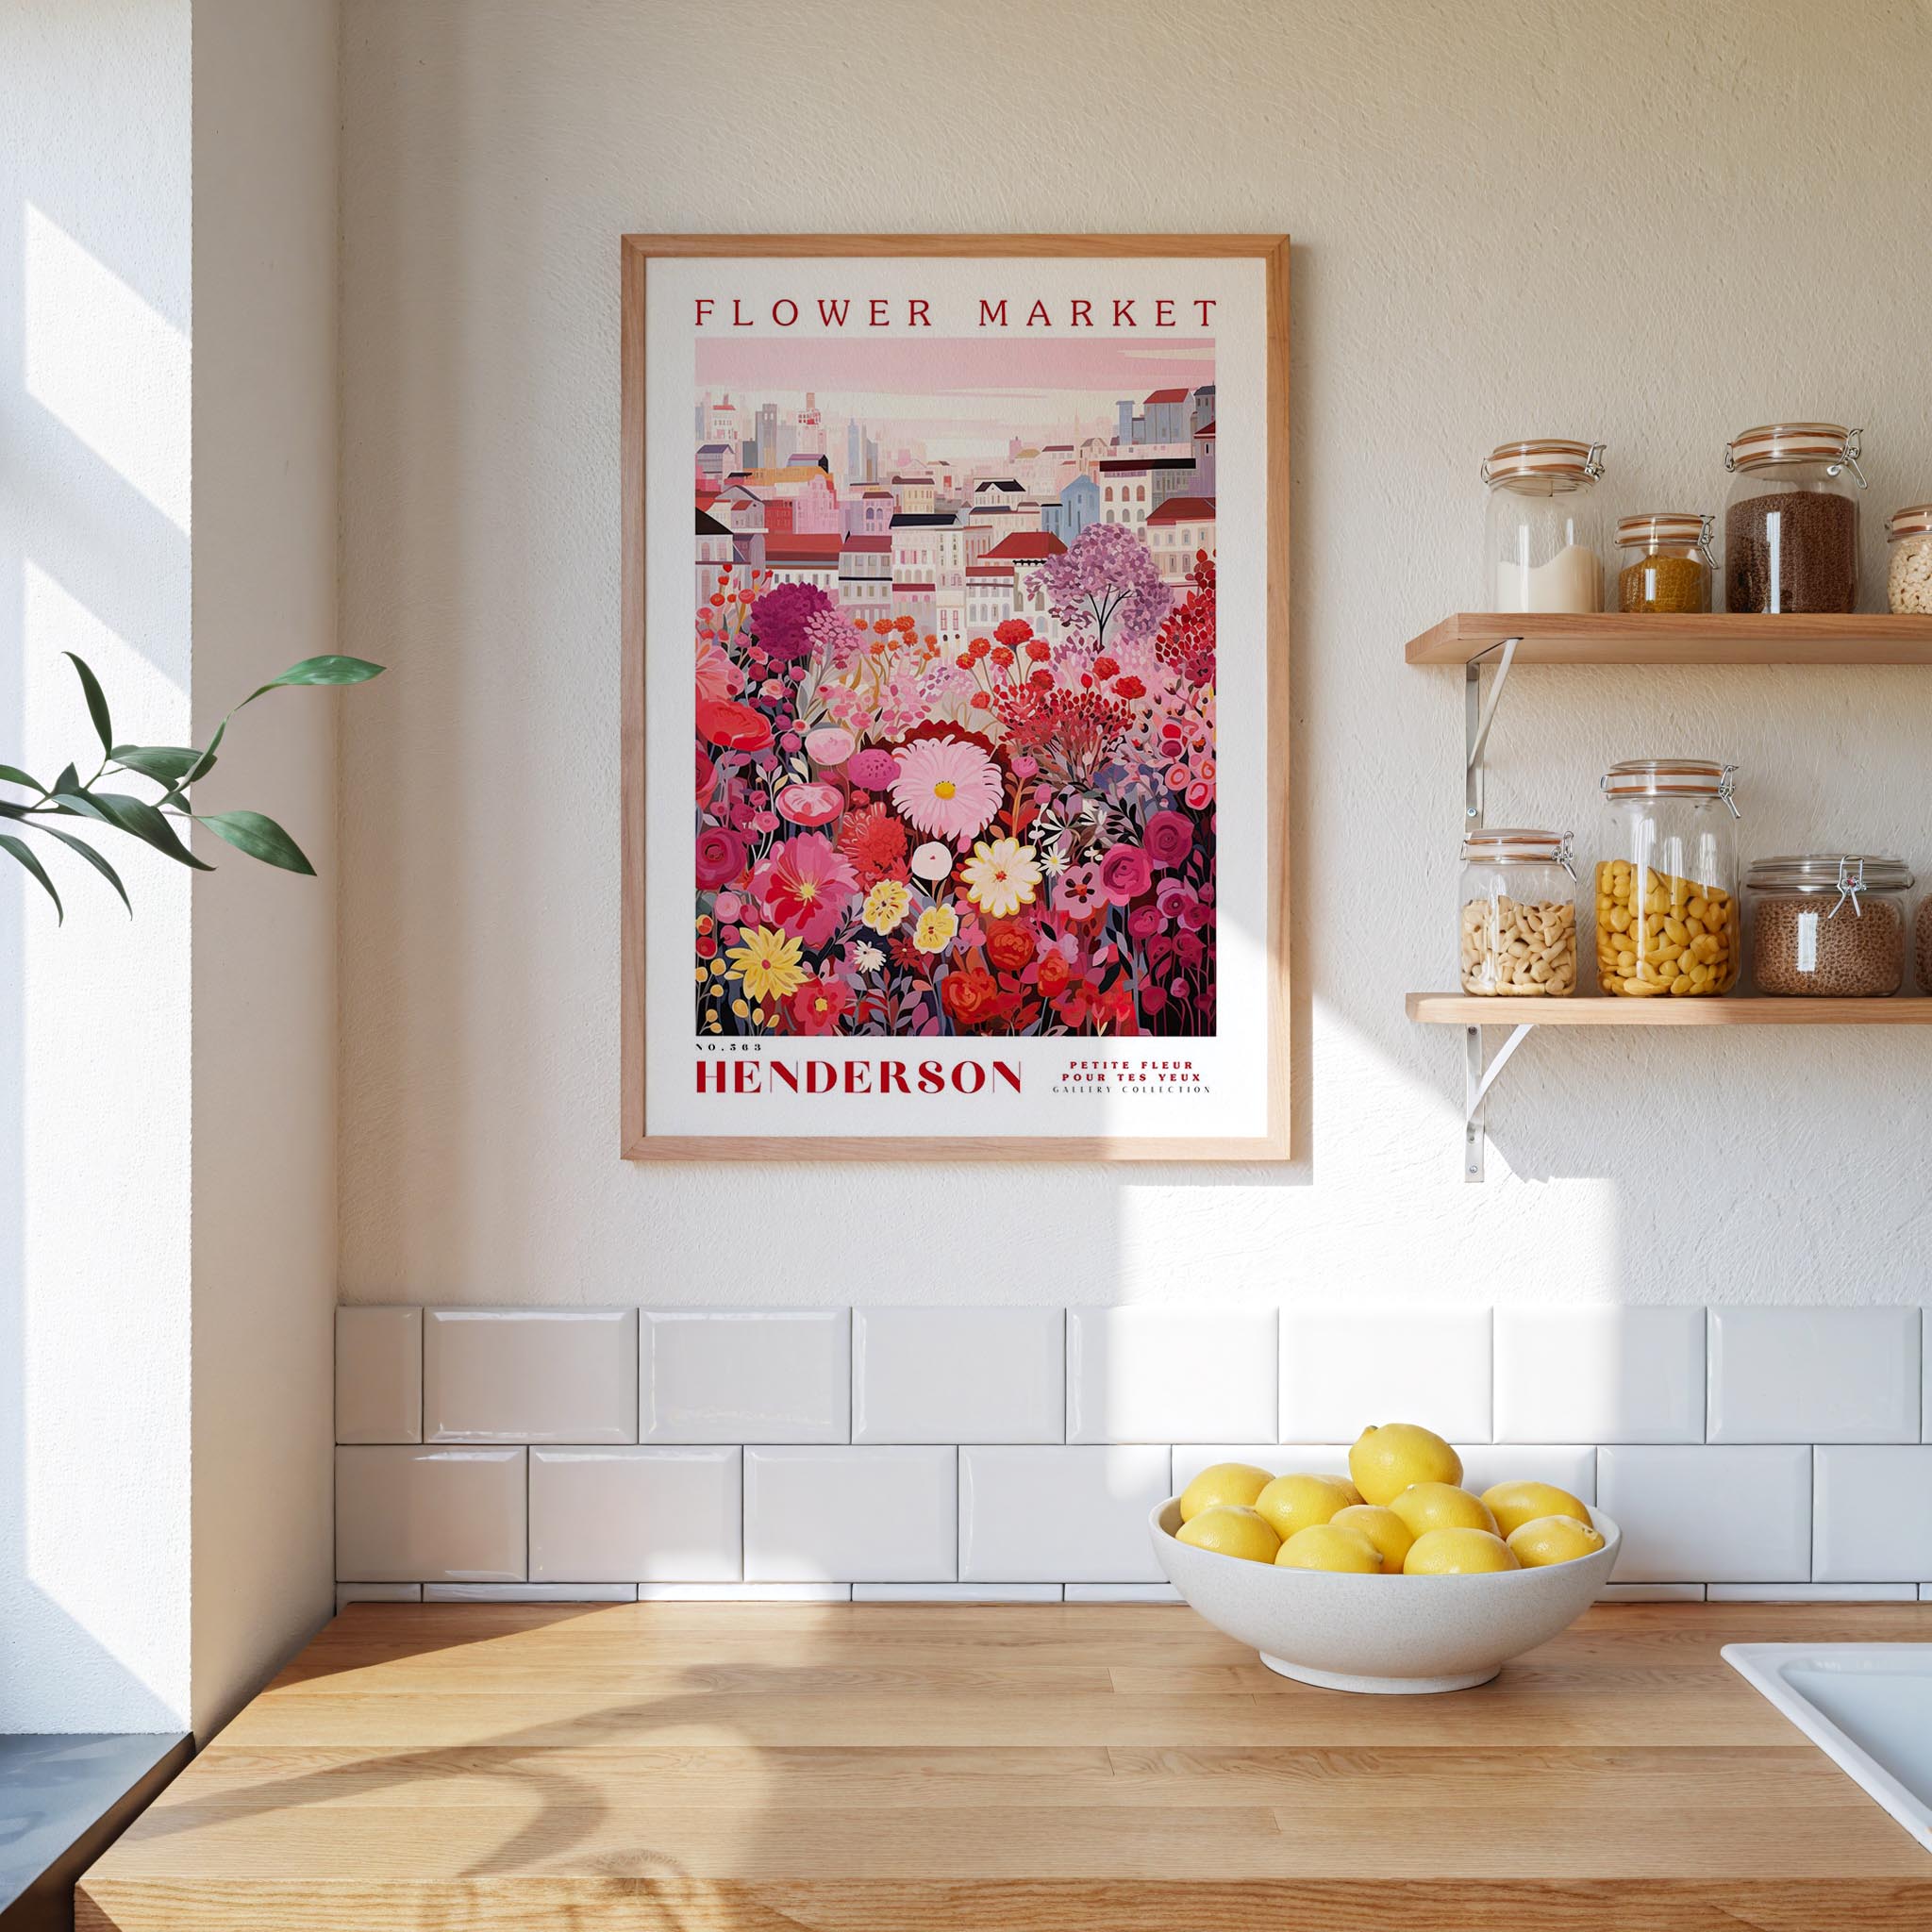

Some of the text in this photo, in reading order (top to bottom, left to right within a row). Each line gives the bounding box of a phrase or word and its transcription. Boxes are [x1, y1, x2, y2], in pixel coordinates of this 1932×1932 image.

[694, 298, 1217, 327] FLOWER MARKET
[1069, 1060, 1193, 1070] PETITE FLEUR
[696, 1060, 1022, 1094] HENDERSON
[1061, 1073, 1201, 1082] POUR TES YEUX
